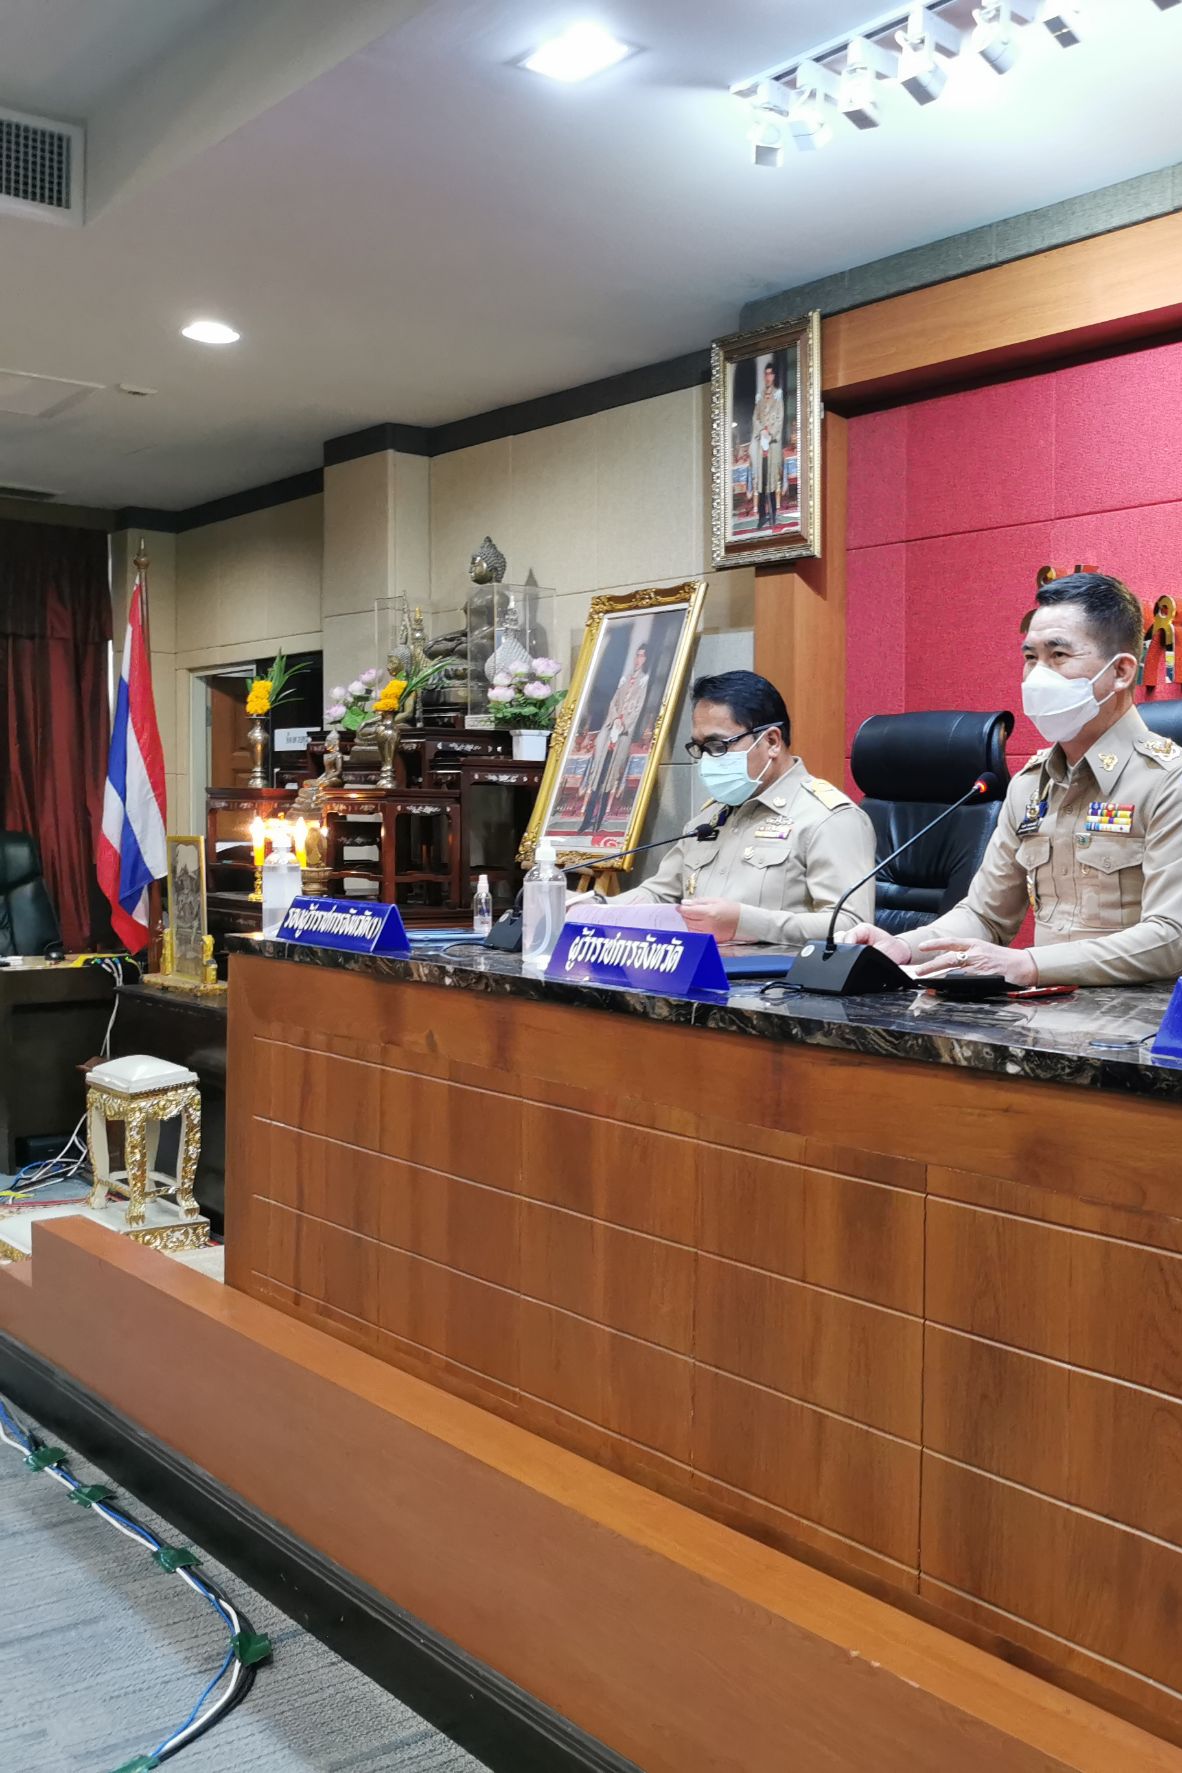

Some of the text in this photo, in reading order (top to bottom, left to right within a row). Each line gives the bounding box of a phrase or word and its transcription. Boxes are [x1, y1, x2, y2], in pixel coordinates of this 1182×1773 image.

[565, 927, 685, 973] ผู้ว่าราชการจังหวัด
